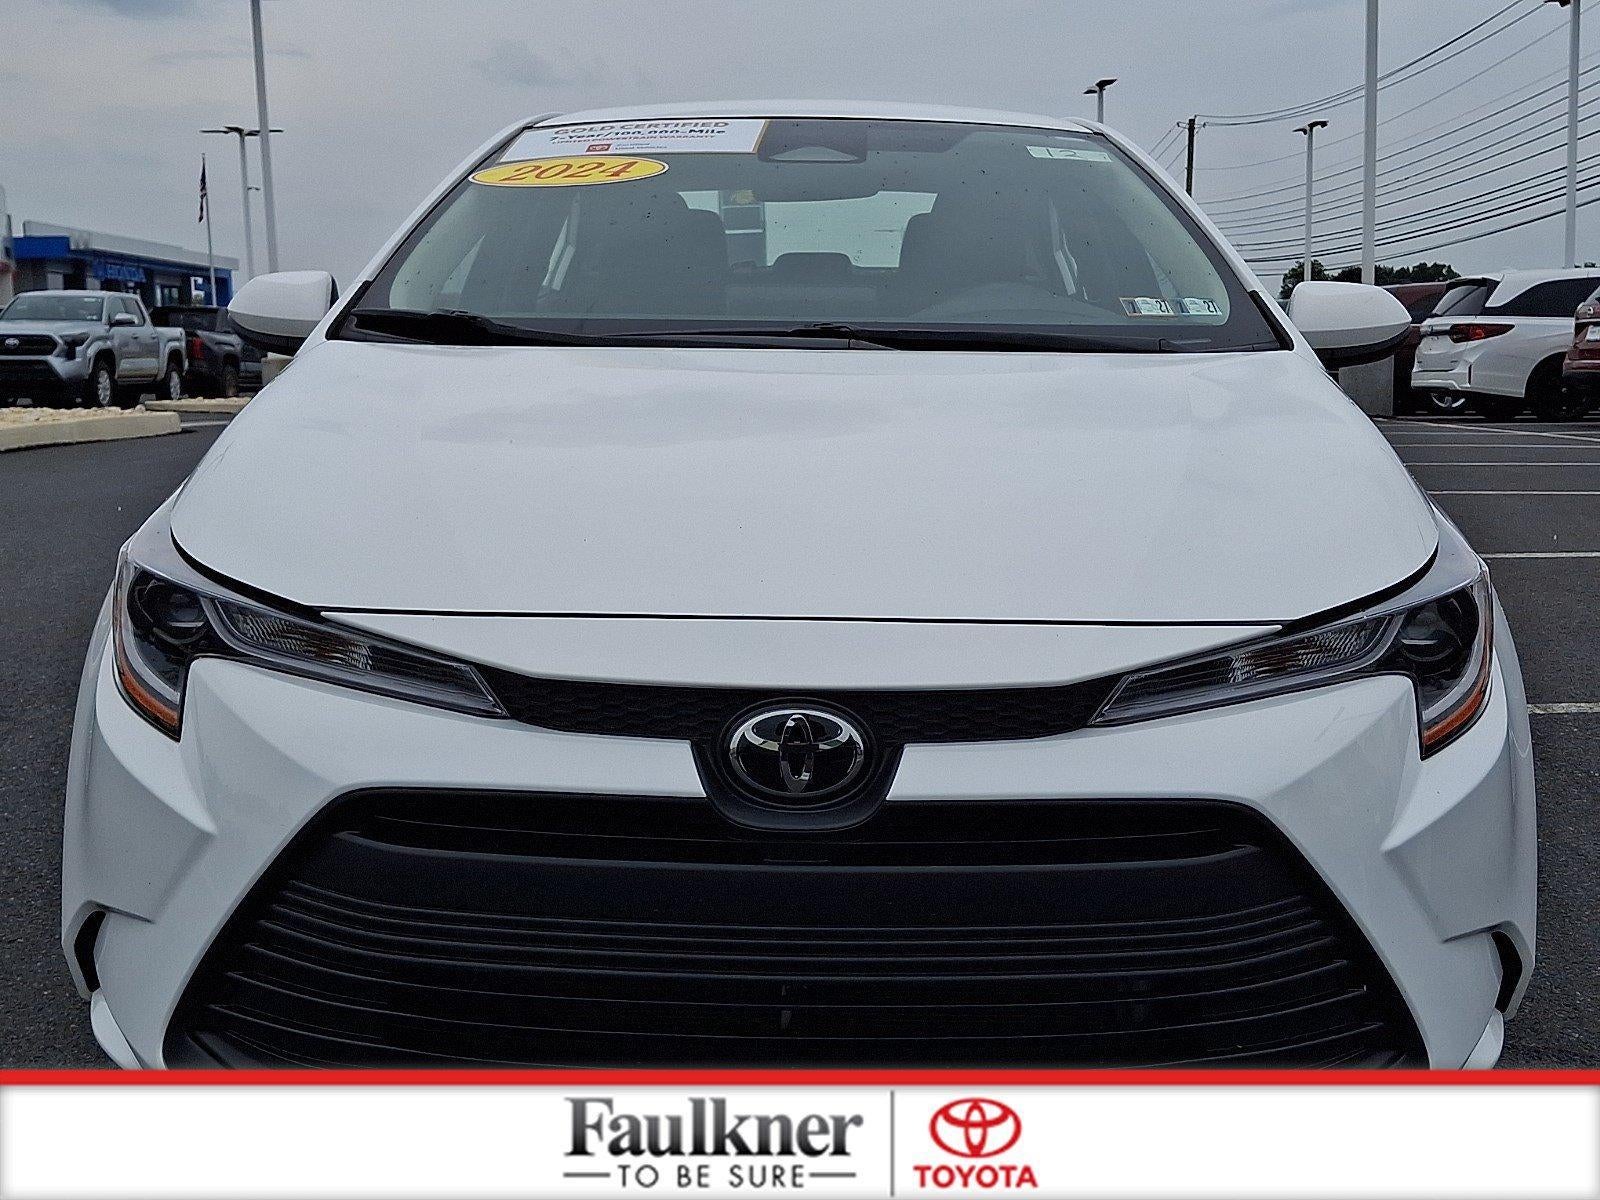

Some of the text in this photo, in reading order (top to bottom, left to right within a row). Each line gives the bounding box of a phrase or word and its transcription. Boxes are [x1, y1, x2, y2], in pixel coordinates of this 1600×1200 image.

[554, 121, 730, 135] GOLD CERTIFIED
[498, 160, 639, 182] 2024
